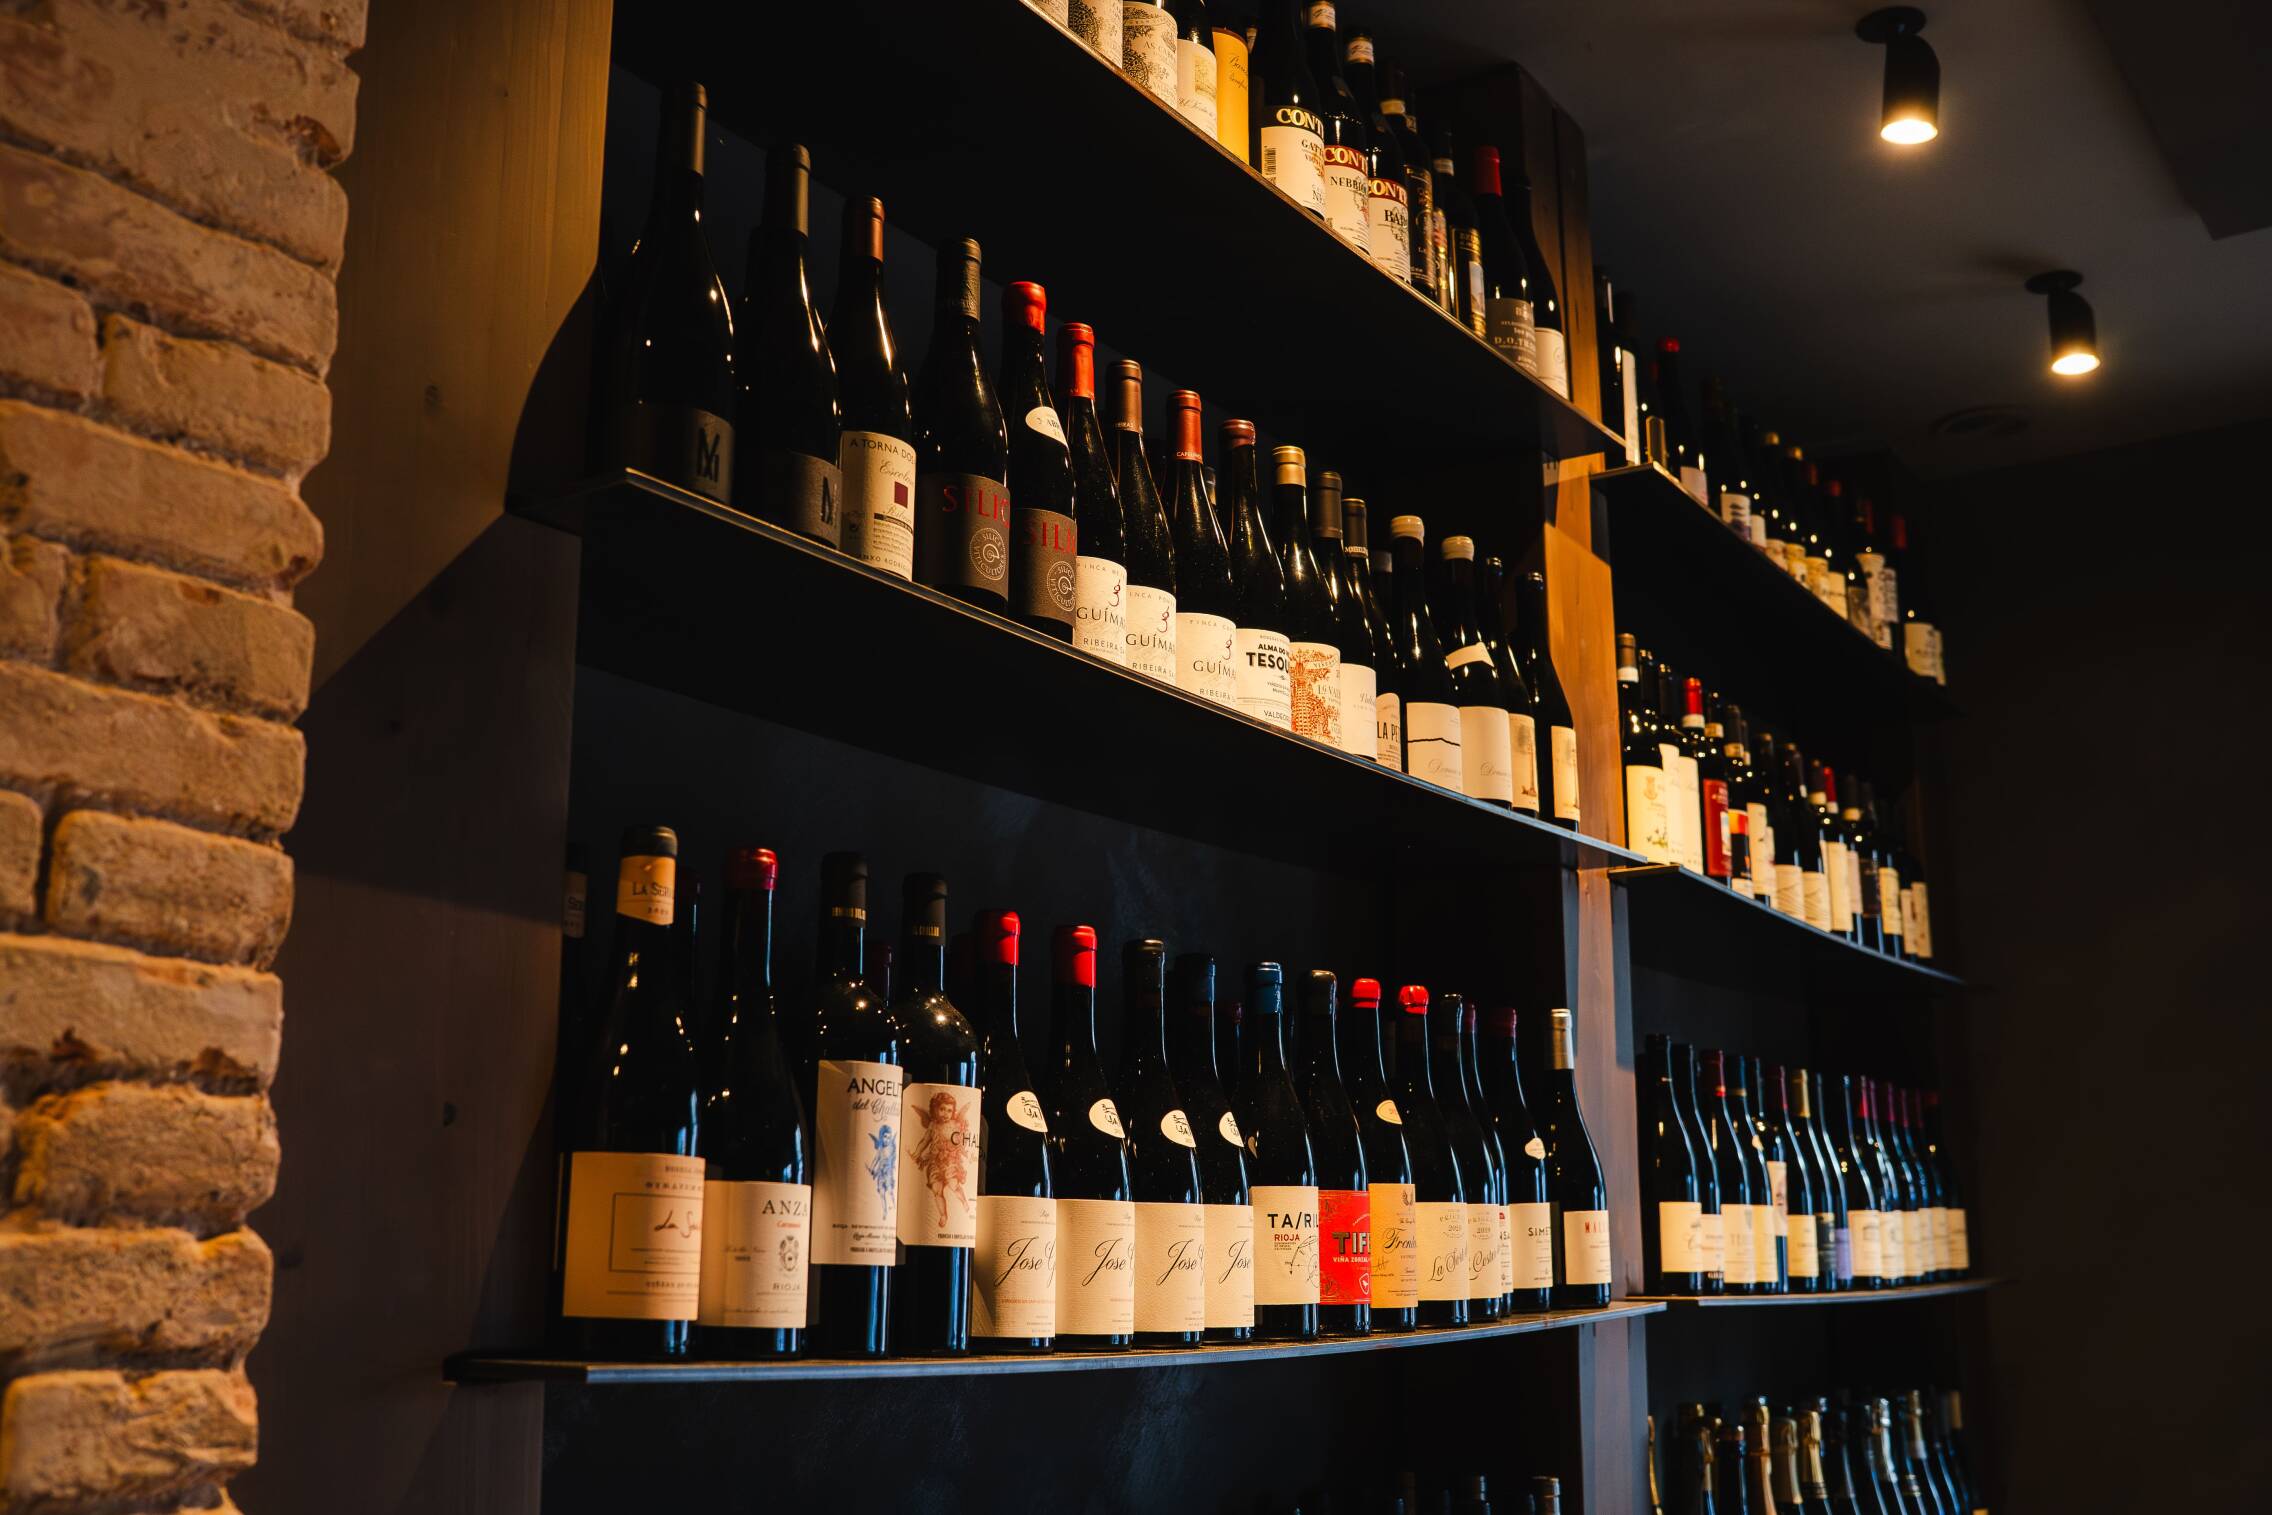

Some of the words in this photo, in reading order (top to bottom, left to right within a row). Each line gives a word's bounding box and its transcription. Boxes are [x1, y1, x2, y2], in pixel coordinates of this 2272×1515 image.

[862, 439, 899, 455] TORNA
[1083, 637, 1118, 651] RIBEIRA
[1258, 643, 1278, 653] ALMA
[1132, 662, 1167, 675] RIBEIRA
[1274, 1233, 1300, 1242] RIOJA
[994, 1236, 1043, 1289] Jose
[1081, 1237, 1127, 1287] Jose
[1156, 1238, 1197, 1287] Jose
